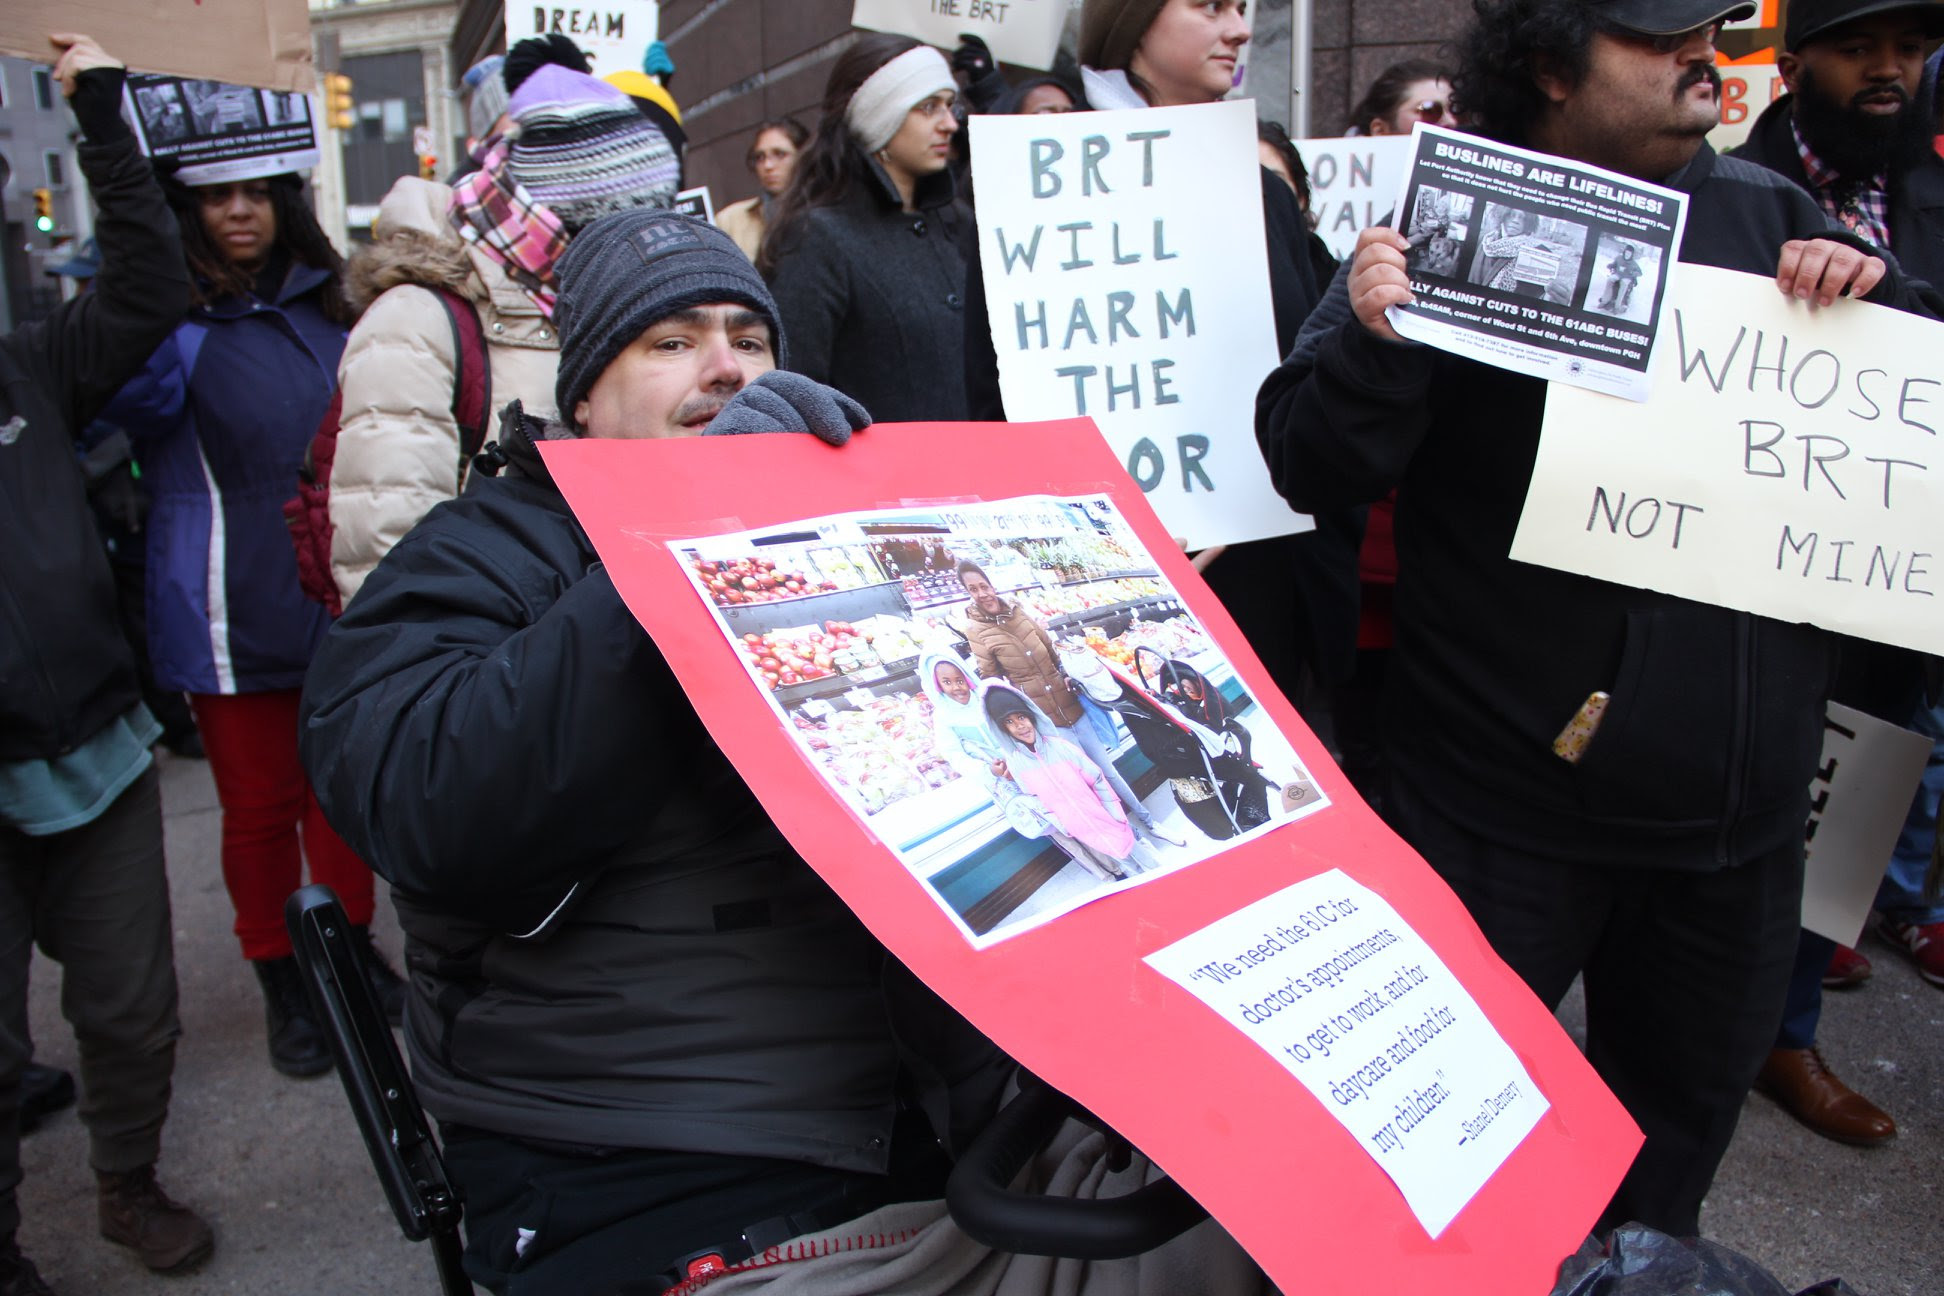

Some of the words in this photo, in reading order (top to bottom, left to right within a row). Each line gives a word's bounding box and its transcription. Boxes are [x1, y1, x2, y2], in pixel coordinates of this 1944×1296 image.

[534, 7, 624, 38] DREAM
[969, 0, 1009, 23] BRT
[1030, 130, 1170, 198] BRT
[1435, 142, 1525, 177] BUSLINES
[1526, 167, 1566, 188] ARE
[1569, 176, 1664, 214] LIFELINES!
[1493, 177, 1507, 187] that
[995, 217, 1178, 275] WILL
[1014, 287, 1197, 350] HARM
[1409, 281, 1431, 294] LLY
[1432, 287, 1485, 307] AGAINST
[1486, 299, 1519, 316] CUTS
[1521, 307, 1538, 320] TO
[1540, 312, 1564, 327] THE
[1565, 319, 1605, 336] 61ABC
[1606, 328, 1649, 347] BUSES!
[1454, 311, 1481, 323] corner
[1482, 316, 1493, 325] of
[1493, 318, 1516, 331] Wood
[1516, 324, 1527, 333] St
[1527, 326, 1543, 337] and
[1544, 331, 1559, 341] 6th
[1559, 335, 1578, 346] Ave,
[1578, 339, 1622, 355] downtown
[1622, 349, 1641, 360] PGH
[1054, 358, 1180, 416] THE
[1674, 308, 1942, 435] WHOSE
[1127, 433, 1215, 493] OR
[1739, 419, 1928, 509] BRT
[1586, 486, 1704, 549] NOT
[1776, 525, 1934, 597] MINE
[1235, 933, 1287, 969] need
[1275, 926, 1310, 945] the
[1299, 904, 1338, 931] 61C
[1328, 897, 1359, 917] for
[1239, 976, 1313, 1025] doctor's
[1306, 928, 1404, 988] appointments,
[1283, 1044, 1311, 1063] to
[1306, 1021, 1340, 1057] get
[1328, 1015, 1354, 1034] to
[1346, 988, 1395, 1023] work,
[1383, 970, 1414, 1000] and
[1401, 964, 1429, 986] for
[1327, 1055, 1392, 1106] daycare
[1386, 1030, 1417, 1065] and
[1404, 1012, 1442, 1048] food
[1430, 1005, 1457, 1028] for
[1484, 1080, 1524, 1117] Demery
[1371, 1122, 1405, 1154] my
